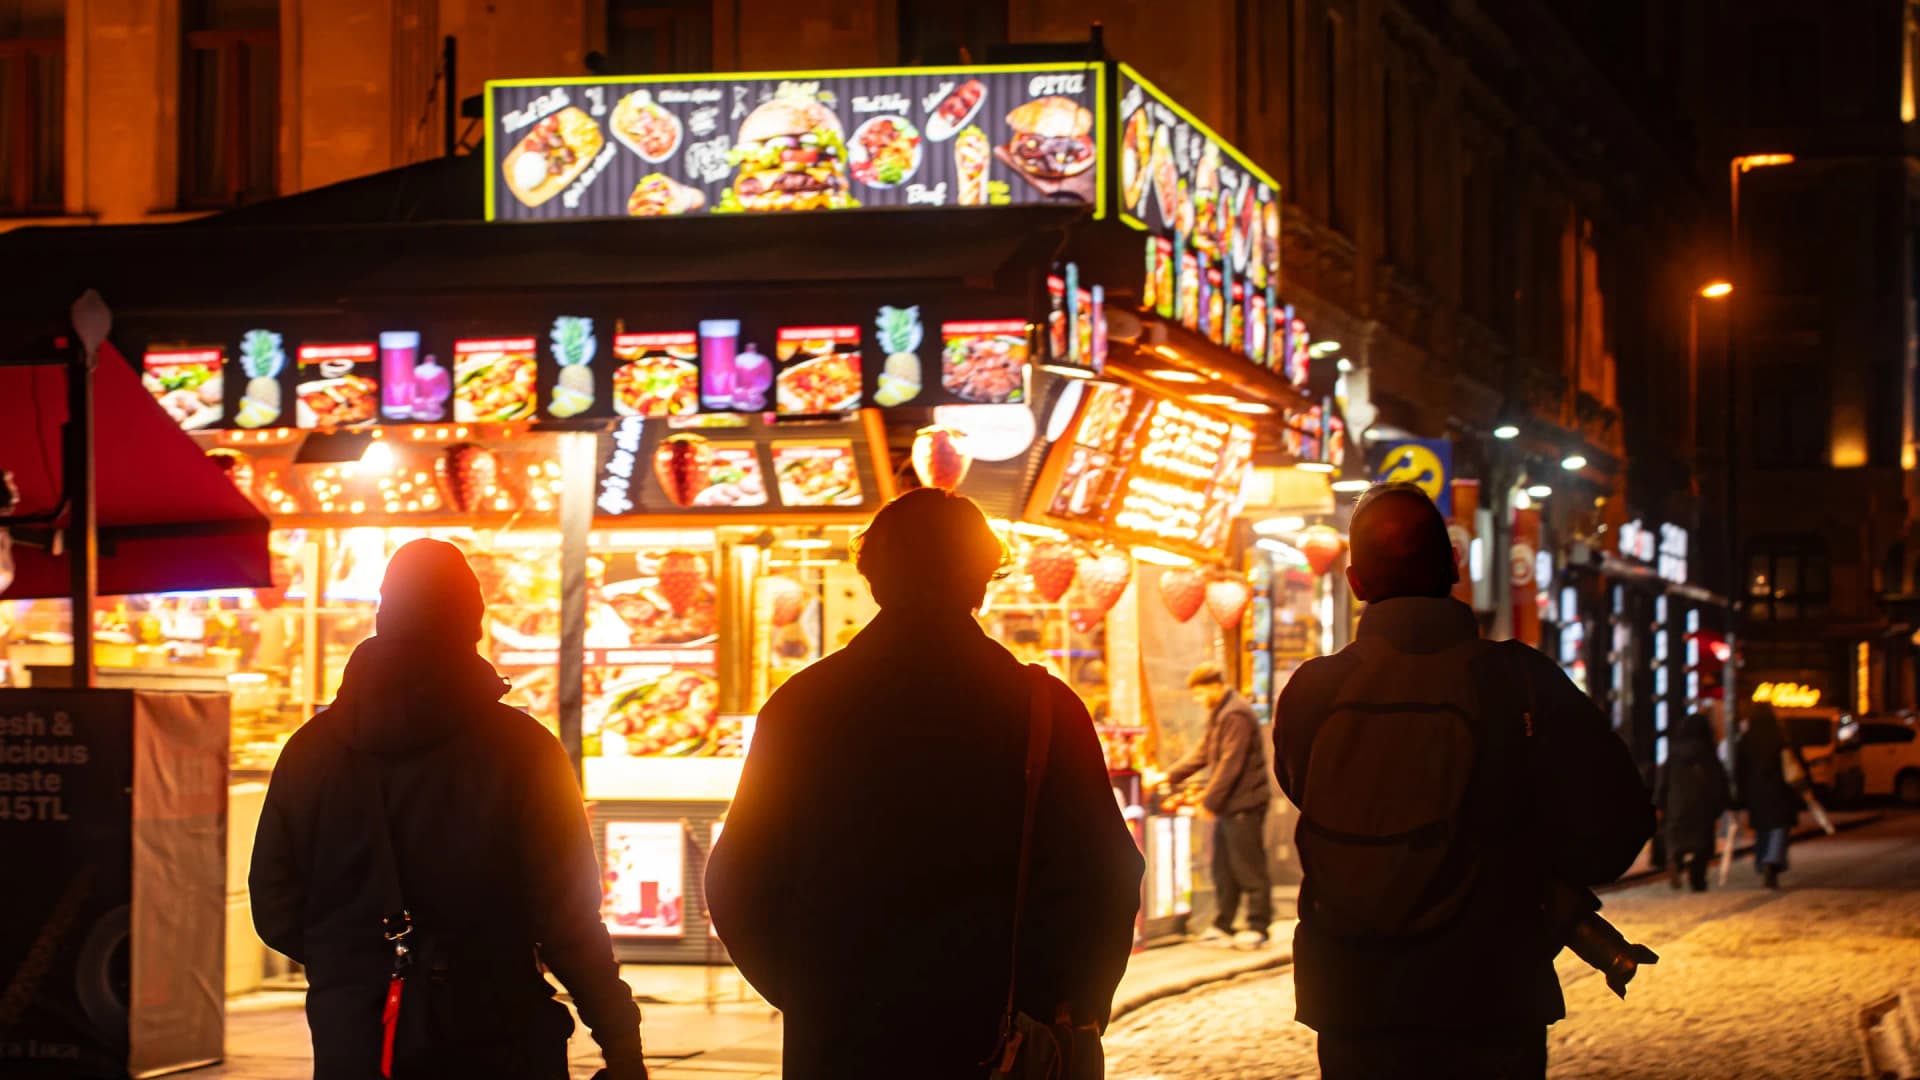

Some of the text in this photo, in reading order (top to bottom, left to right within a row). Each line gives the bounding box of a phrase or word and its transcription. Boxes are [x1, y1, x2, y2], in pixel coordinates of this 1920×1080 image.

[0, 712, 73, 737] esh &
[0, 738, 89, 765] icious
[0, 767, 62, 792] aste
